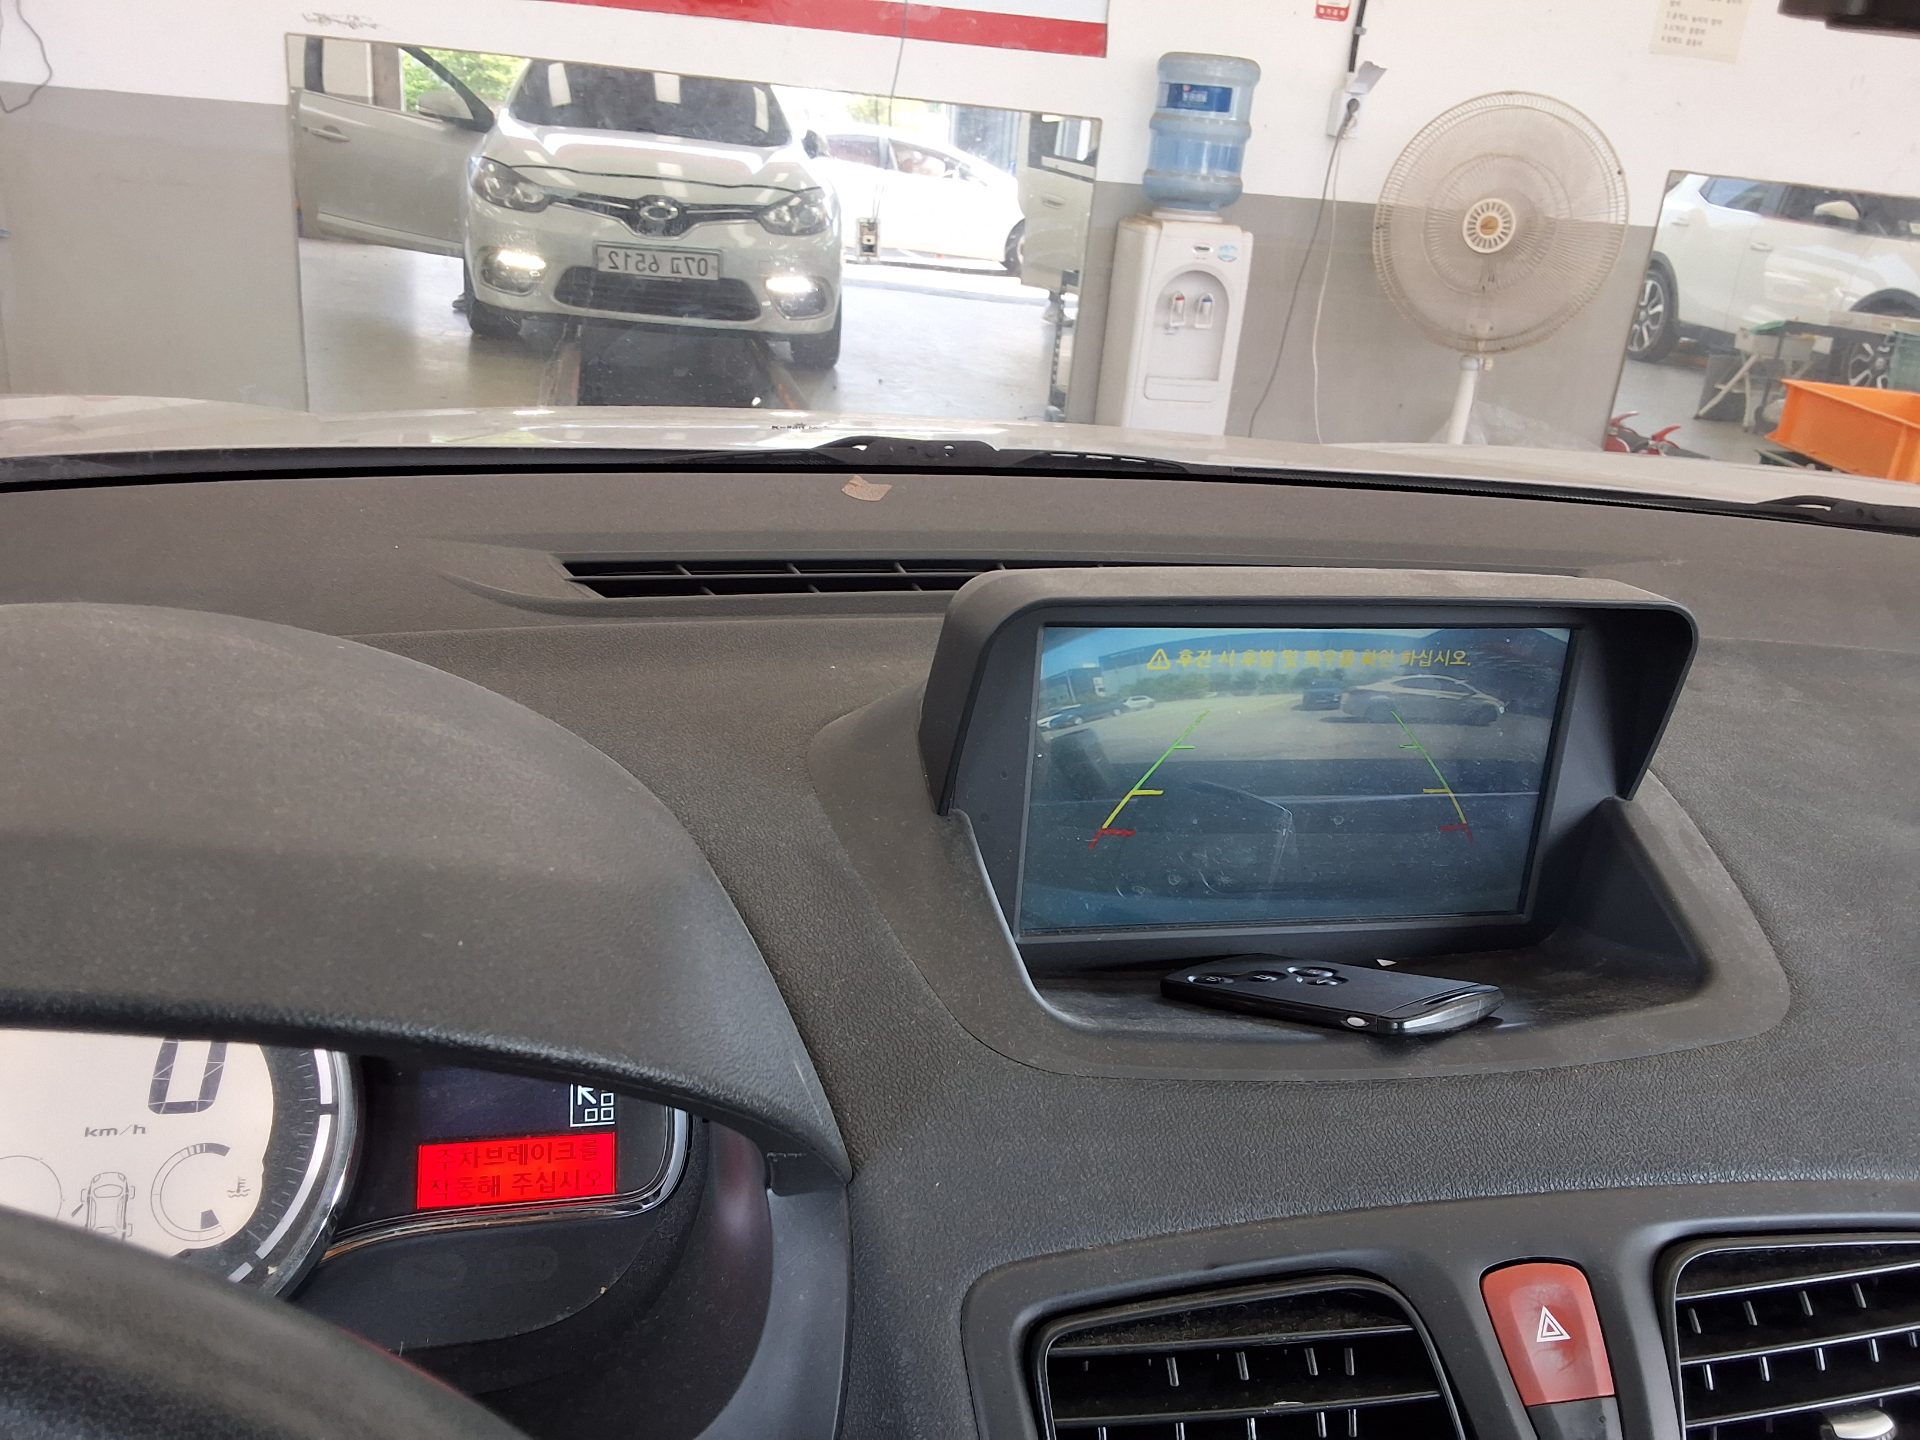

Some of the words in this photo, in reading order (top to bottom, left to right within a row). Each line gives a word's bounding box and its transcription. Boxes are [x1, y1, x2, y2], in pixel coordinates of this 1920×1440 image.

[1176, 649, 1211, 669] 후진
[1219, 649, 1236, 669] 시
[1400, 649, 1472, 668] 하십시오.
[84, 1124, 147, 1138] km/h
[435, 1138, 599, 1169] 주차브레이크를
[431, 1174, 501, 1201] 작동해
[511, 1168, 605, 1196] 주십시오
